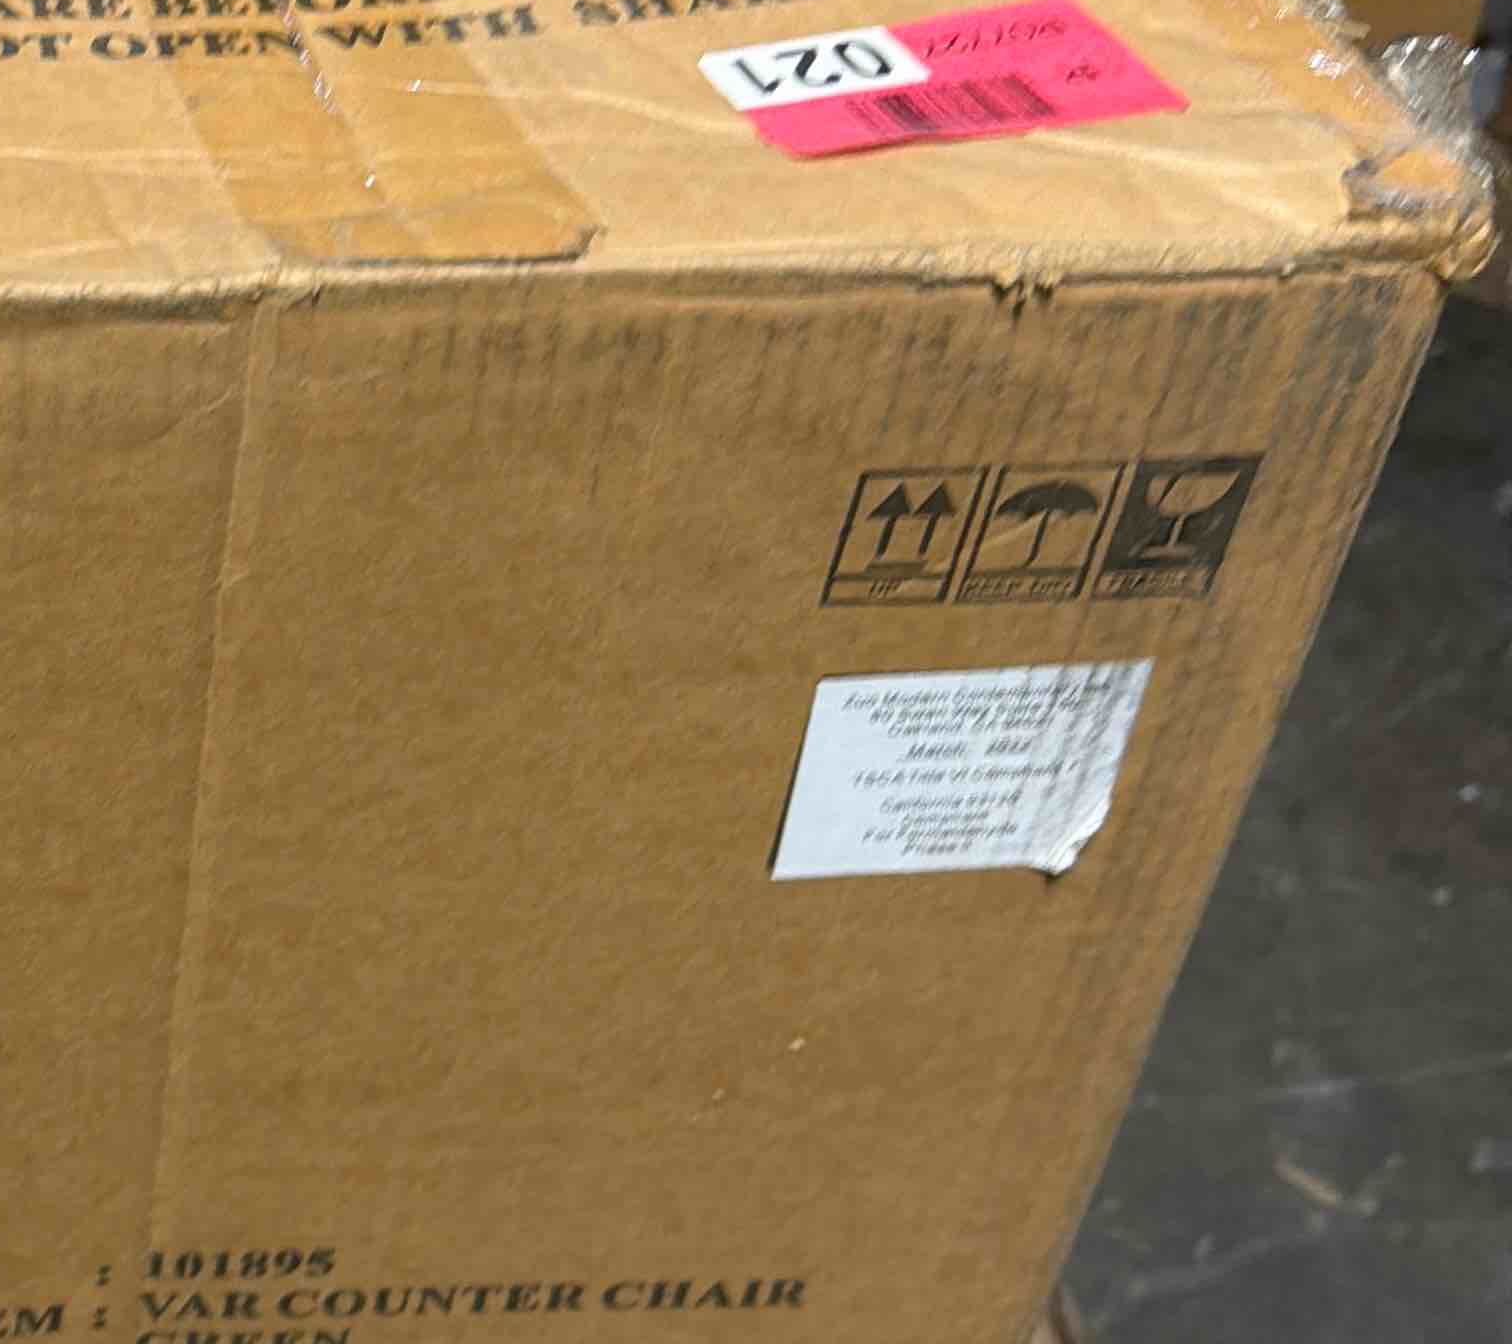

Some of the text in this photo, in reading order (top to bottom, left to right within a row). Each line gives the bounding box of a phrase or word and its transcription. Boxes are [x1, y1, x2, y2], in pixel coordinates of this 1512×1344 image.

[89, 29, 302, 60] OPEN
[315, 2, 545, 52] WITH
[732, 37, 895, 96] 021
[143, 1247, 337, 1281] 101895
[137, 1289, 266, 1323] VAR
[277, 1282, 588, 1321] COUNTER
[600, 1276, 811, 1313] CHAIR
